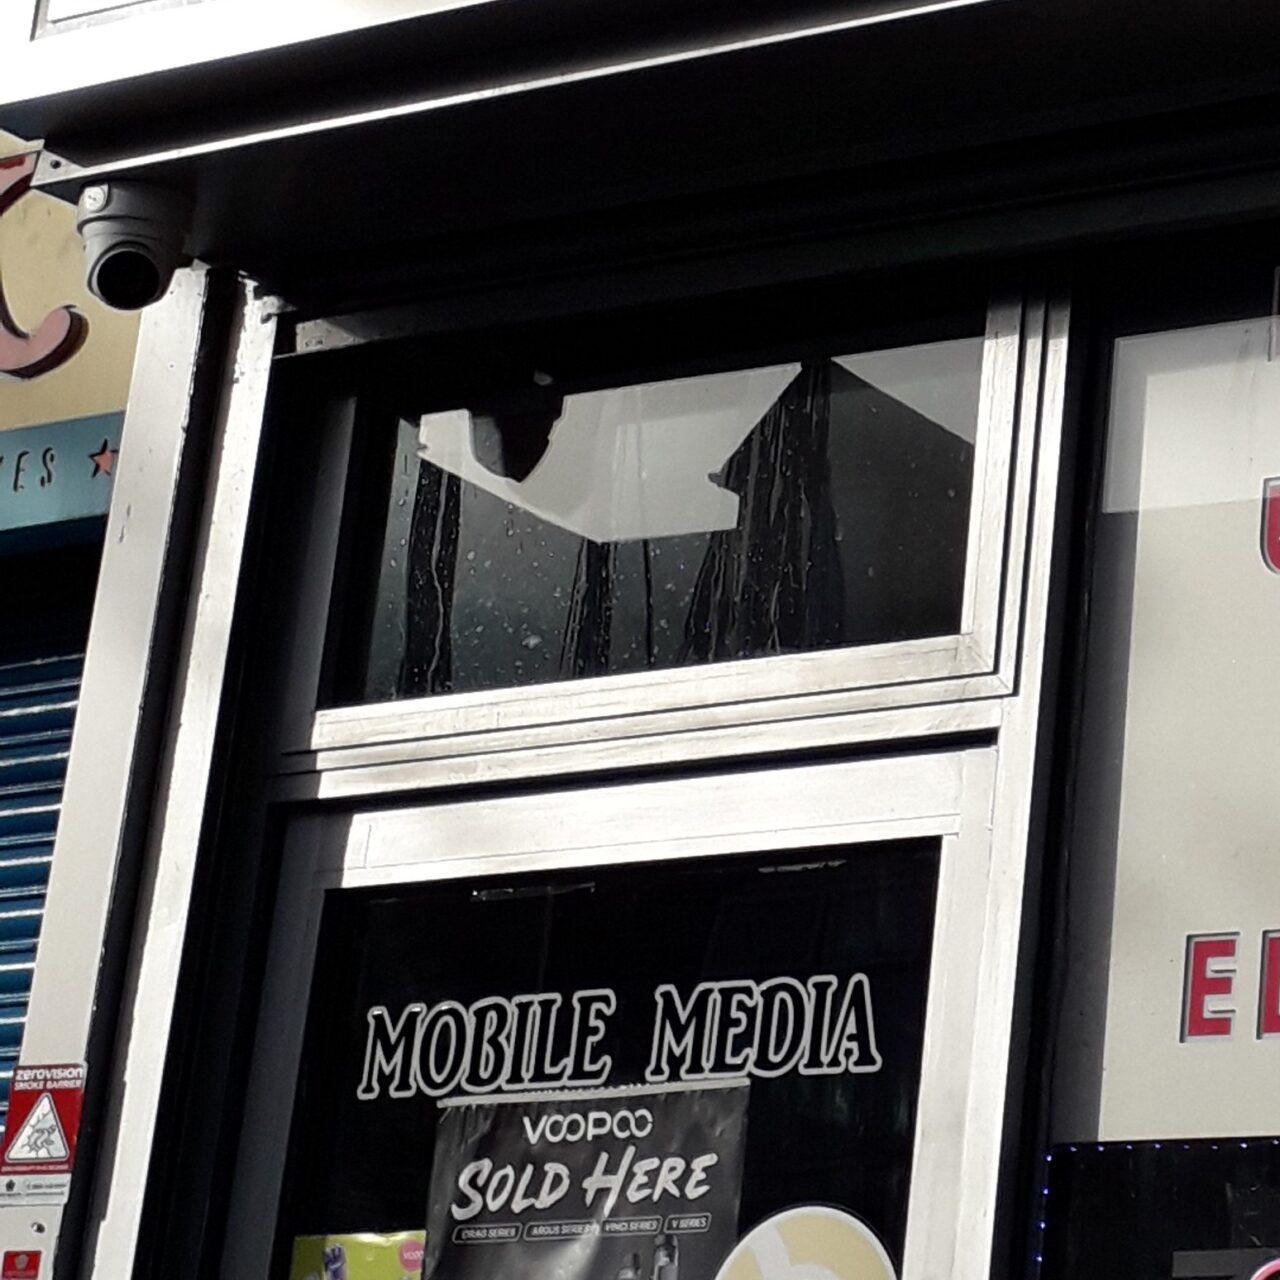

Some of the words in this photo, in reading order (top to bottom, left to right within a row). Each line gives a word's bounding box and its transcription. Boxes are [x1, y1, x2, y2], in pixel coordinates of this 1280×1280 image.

[357, 988, 616, 1100] MOBILE
[645, 973, 882, 1081] MEDIA
[522, 1108, 653, 1145] VOOPOO
[450, 1157, 570, 1220] SOLD
[582, 1145, 719, 1218] HERE
